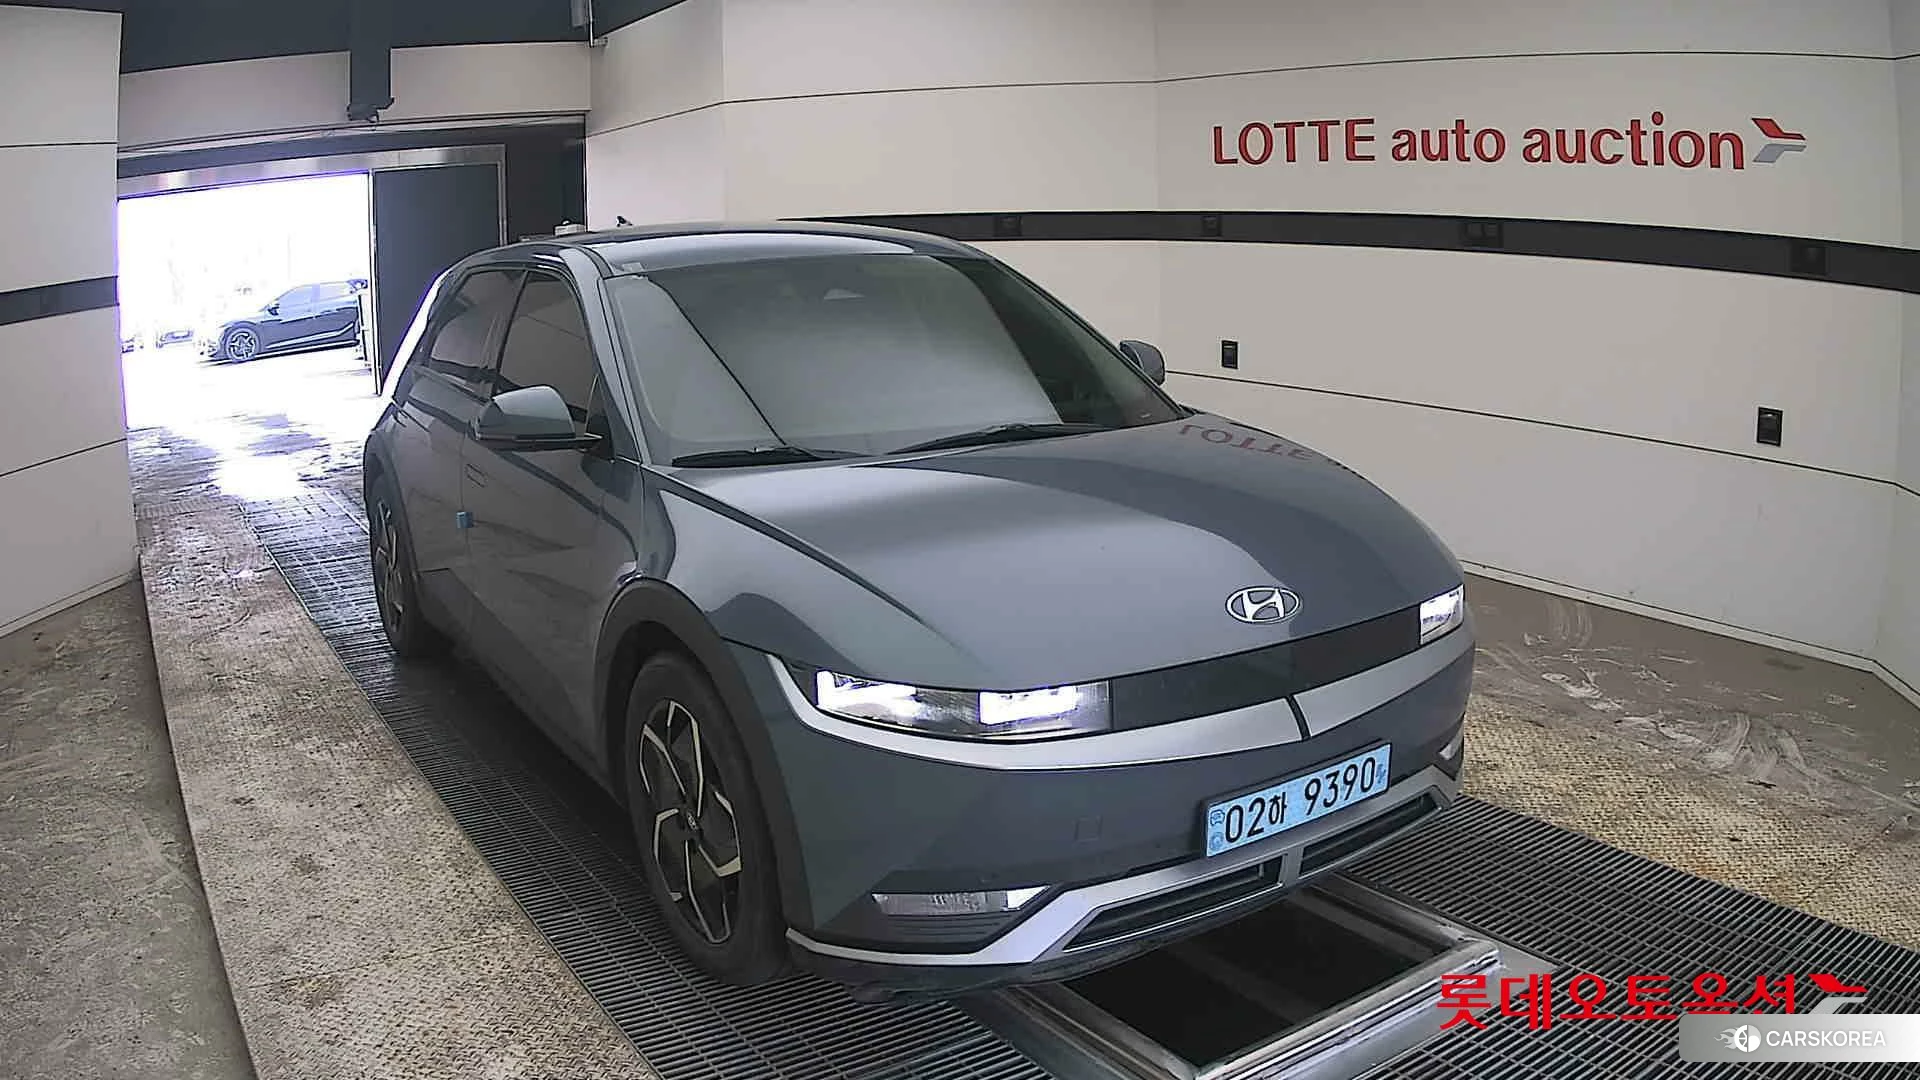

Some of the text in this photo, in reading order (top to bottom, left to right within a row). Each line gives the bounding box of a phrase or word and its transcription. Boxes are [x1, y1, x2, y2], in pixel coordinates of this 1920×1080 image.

[1213, 111, 1745, 170] LOTTE auto auction
[1225, 757, 1376, 843] 02하 9390
